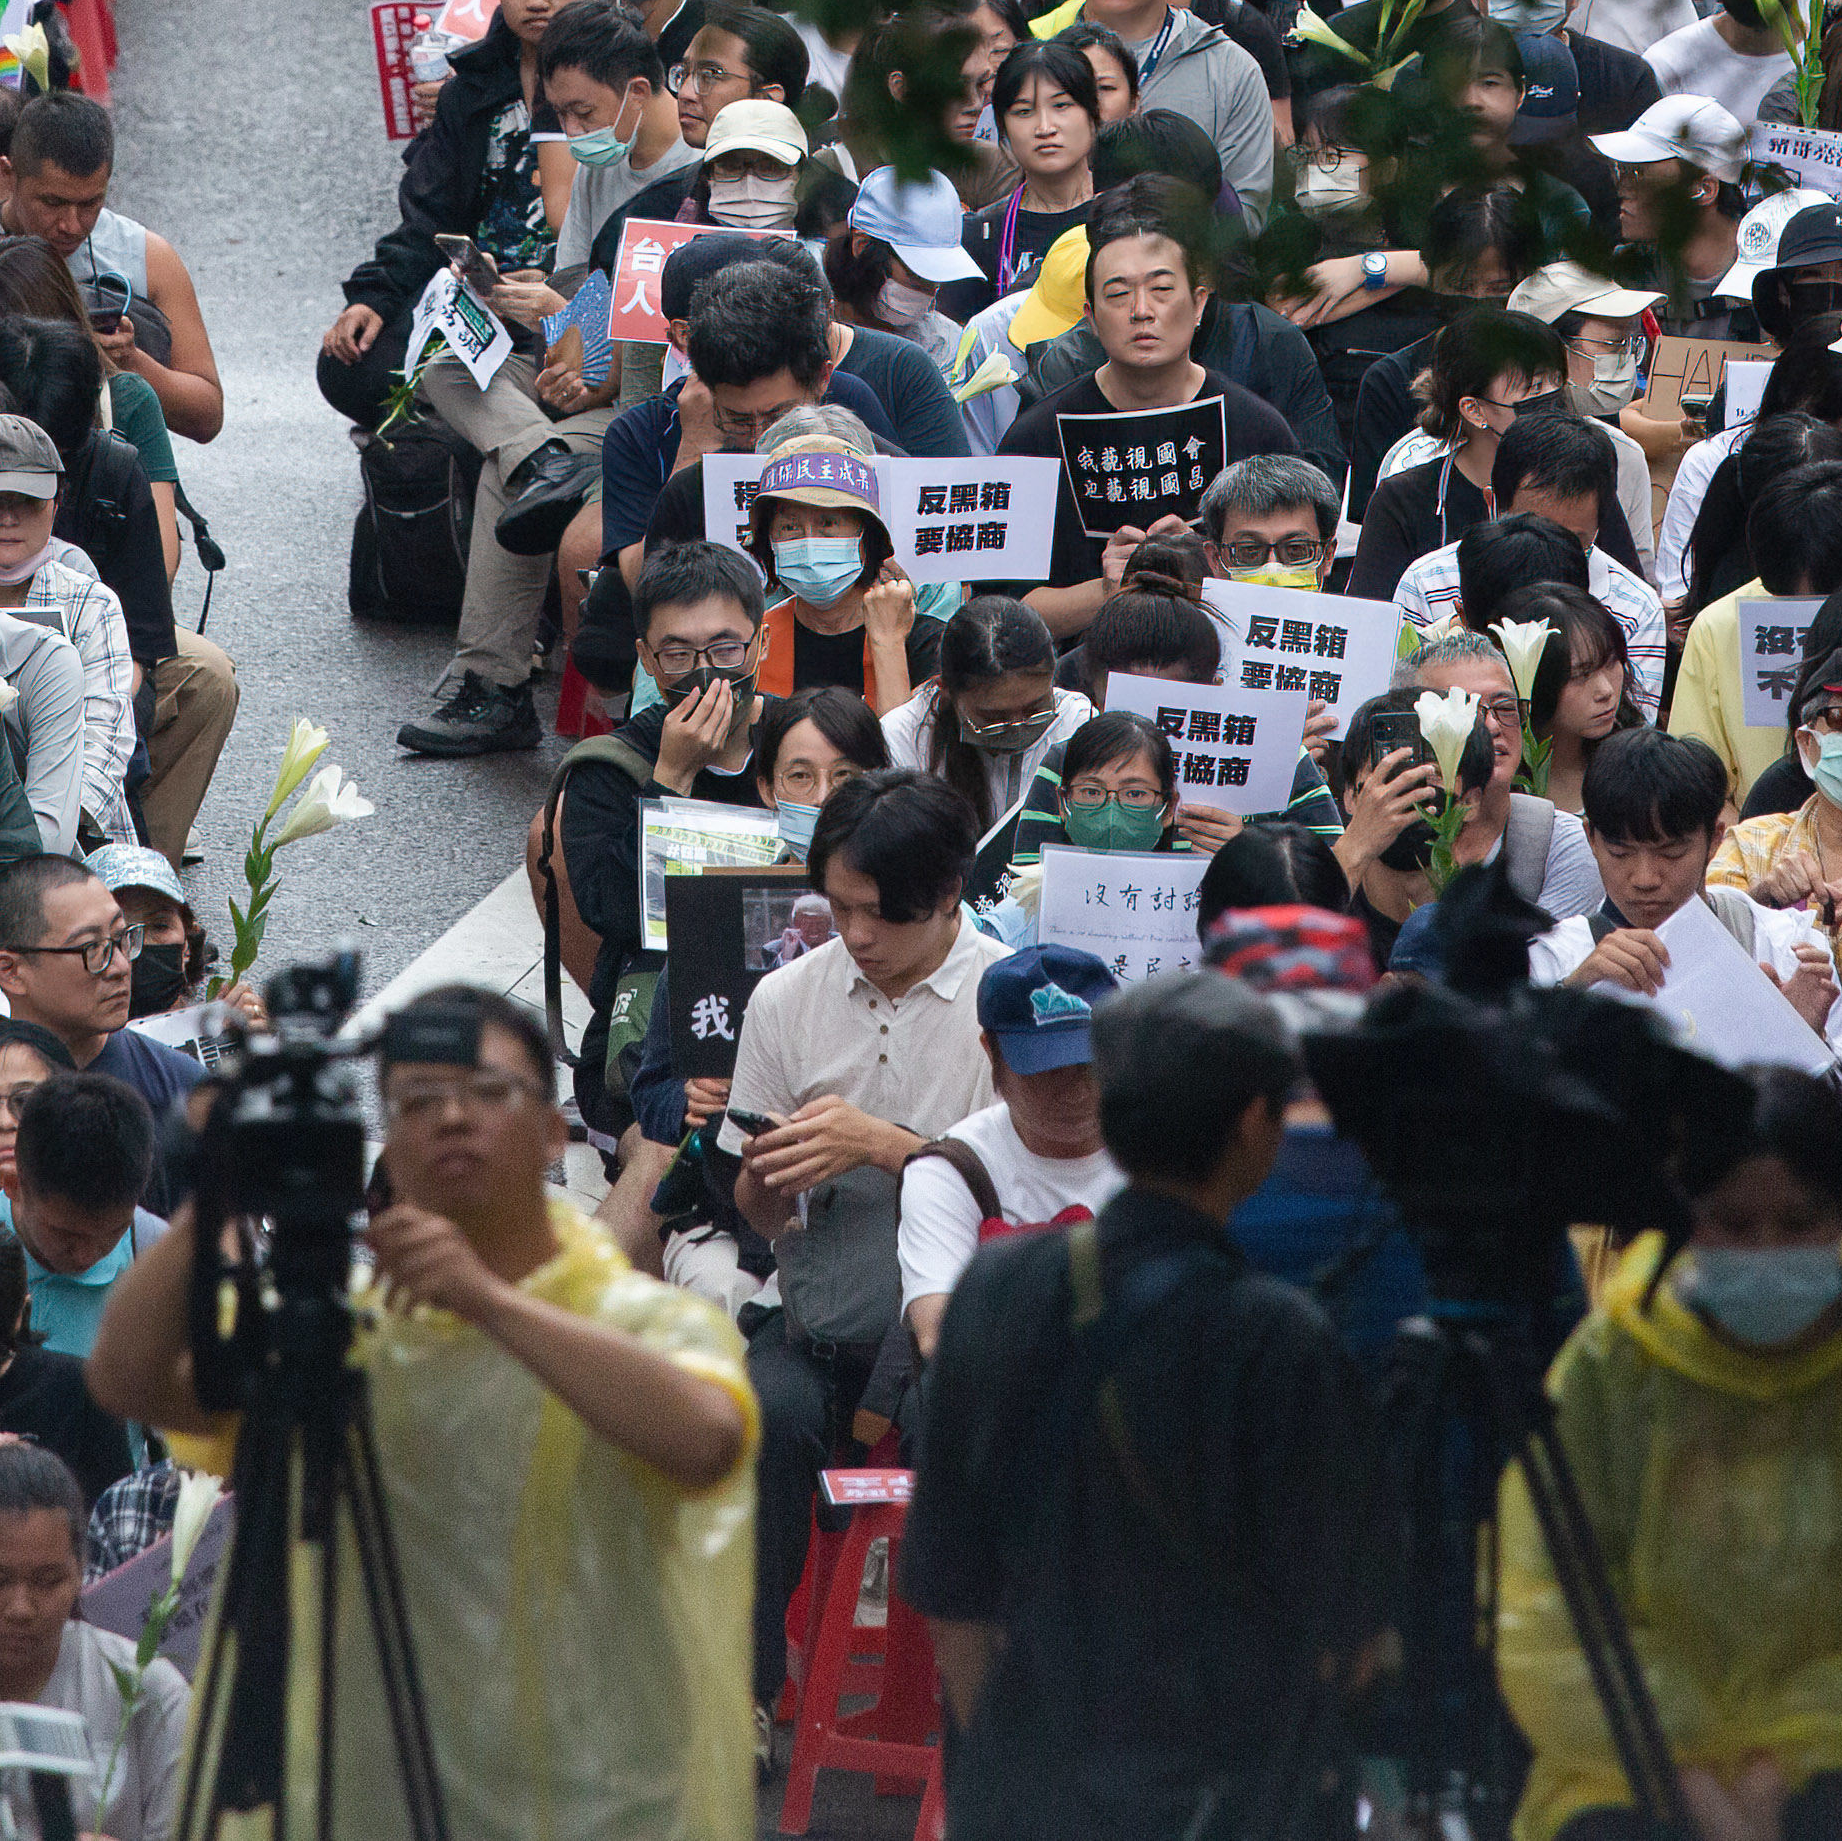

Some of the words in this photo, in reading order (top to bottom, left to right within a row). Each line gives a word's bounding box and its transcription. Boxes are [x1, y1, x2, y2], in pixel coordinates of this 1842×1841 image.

[631, 236, 685, 272] 台
[621, 279, 656, 316] 人
[1077, 435, 1206, 474] 我藐視國會
[916, 481, 1012, 516] 反黑箱
[914, 521, 1008, 556] 要協商
[1244, 614, 1348, 660] 反黑箱
[1239, 659, 1342, 705] 要協商
[1756, 670, 1797, 701] 不
[1154, 705, 1257, 747] 反黑箱
[690, 994, 735, 1040] 我
